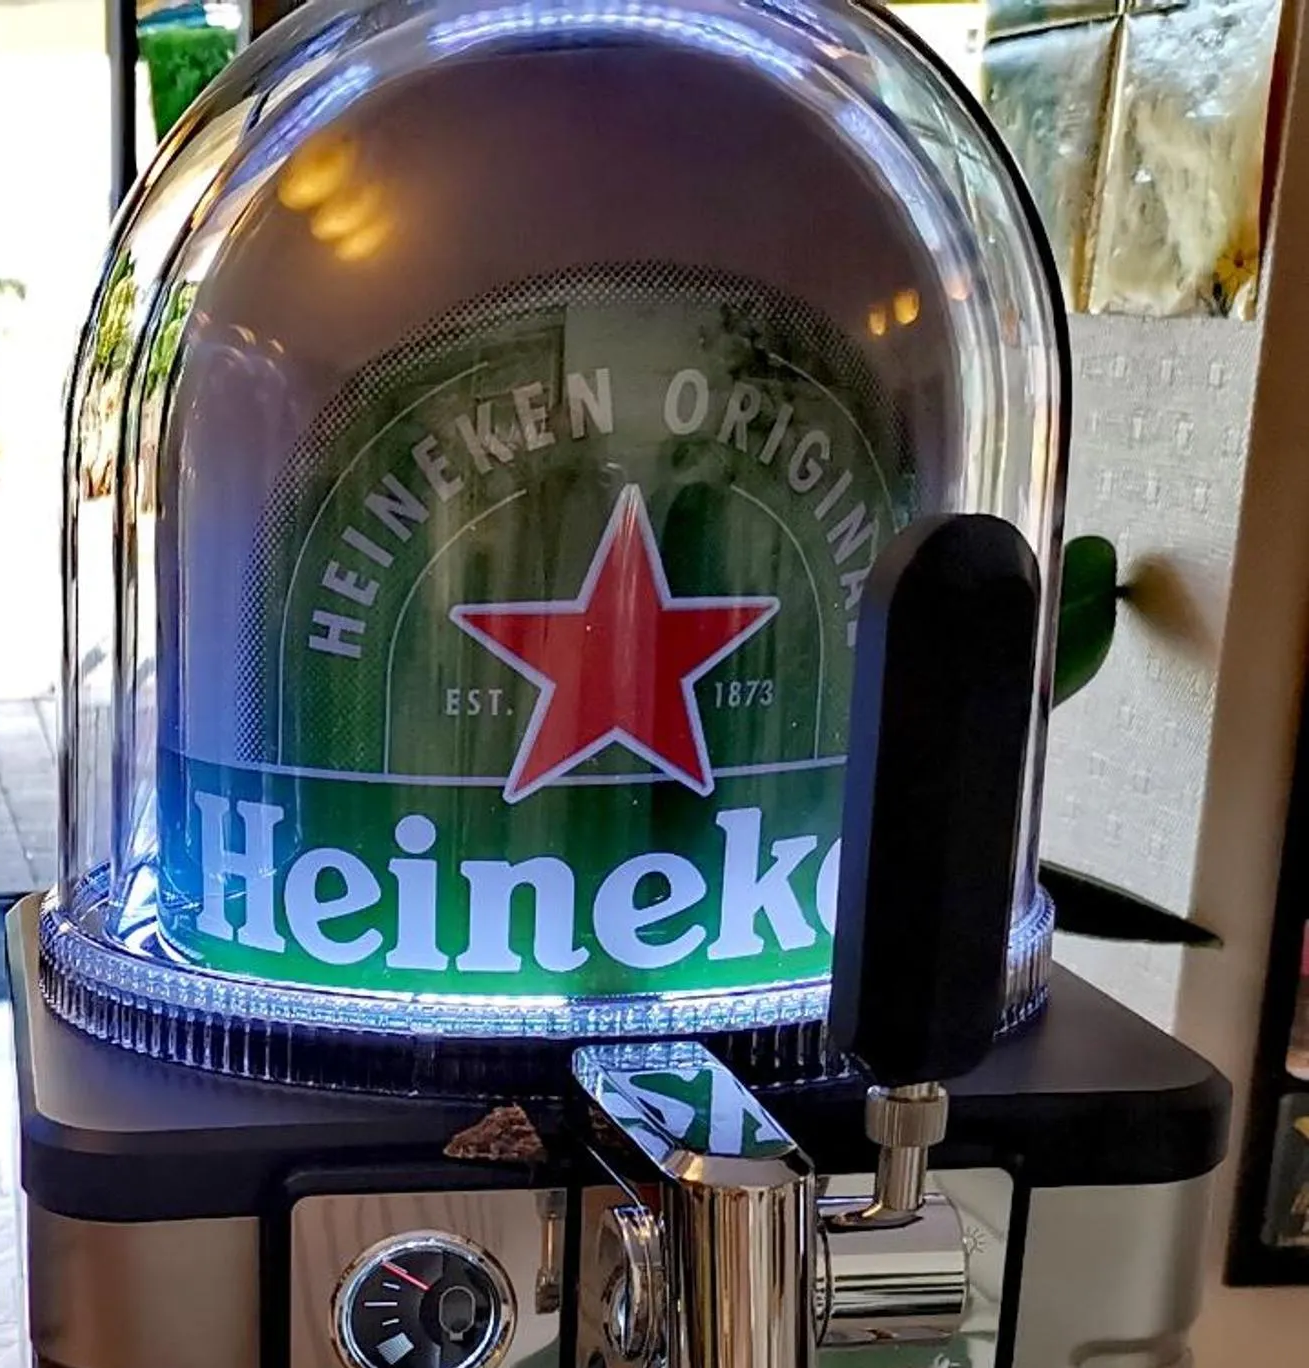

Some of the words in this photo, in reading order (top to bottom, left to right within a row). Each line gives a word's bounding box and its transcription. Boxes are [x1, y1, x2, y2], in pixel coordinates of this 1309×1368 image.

[308, 368, 615, 659] HEINEKEN
[663, 368, 880, 647] ORIGINA
[445, 688, 513, 716] EST.
[714, 679, 774, 708] 1873
[193, 790, 842, 973] Heinek
